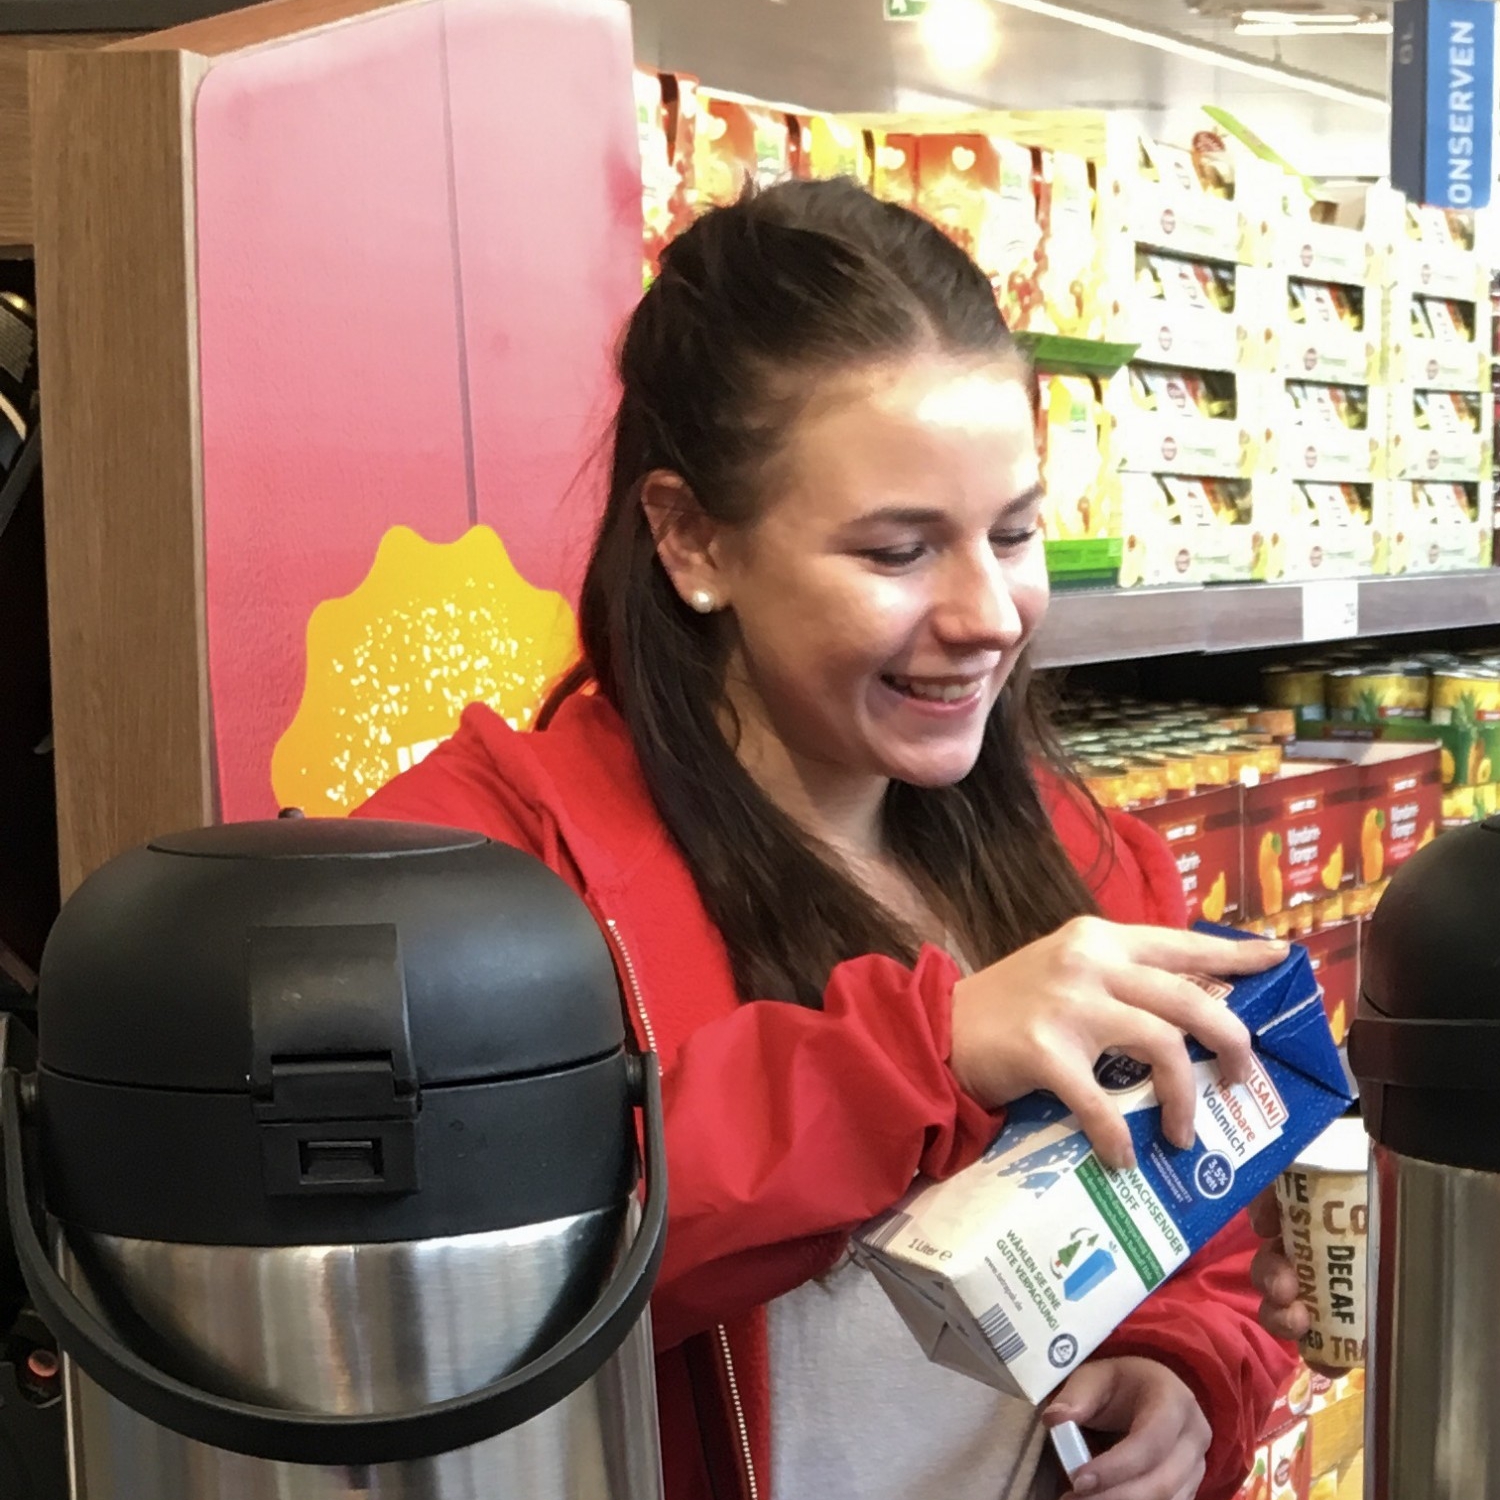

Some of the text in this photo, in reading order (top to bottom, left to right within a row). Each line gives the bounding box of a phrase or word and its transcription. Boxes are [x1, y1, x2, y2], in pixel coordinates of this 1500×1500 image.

[1447, 20, 1475, 206] ONSERVEN
[1202, 1084, 1248, 1157] Vollmilch
[1215, 1076, 1257, 1142] Haltbare
[1247, 1068, 1281, 1122] ILSANI
[1201, 1168, 1219, 1191] Fett
[1207, 1158, 1229, 1186] 3,5%
[996, 1238, 1060, 1331] GUTE VERPACKUNG!
[1006, 1229, 1061, 1311] WÄHLEN SIE EINE
[1327, 1245, 1355, 1325] DECAF
